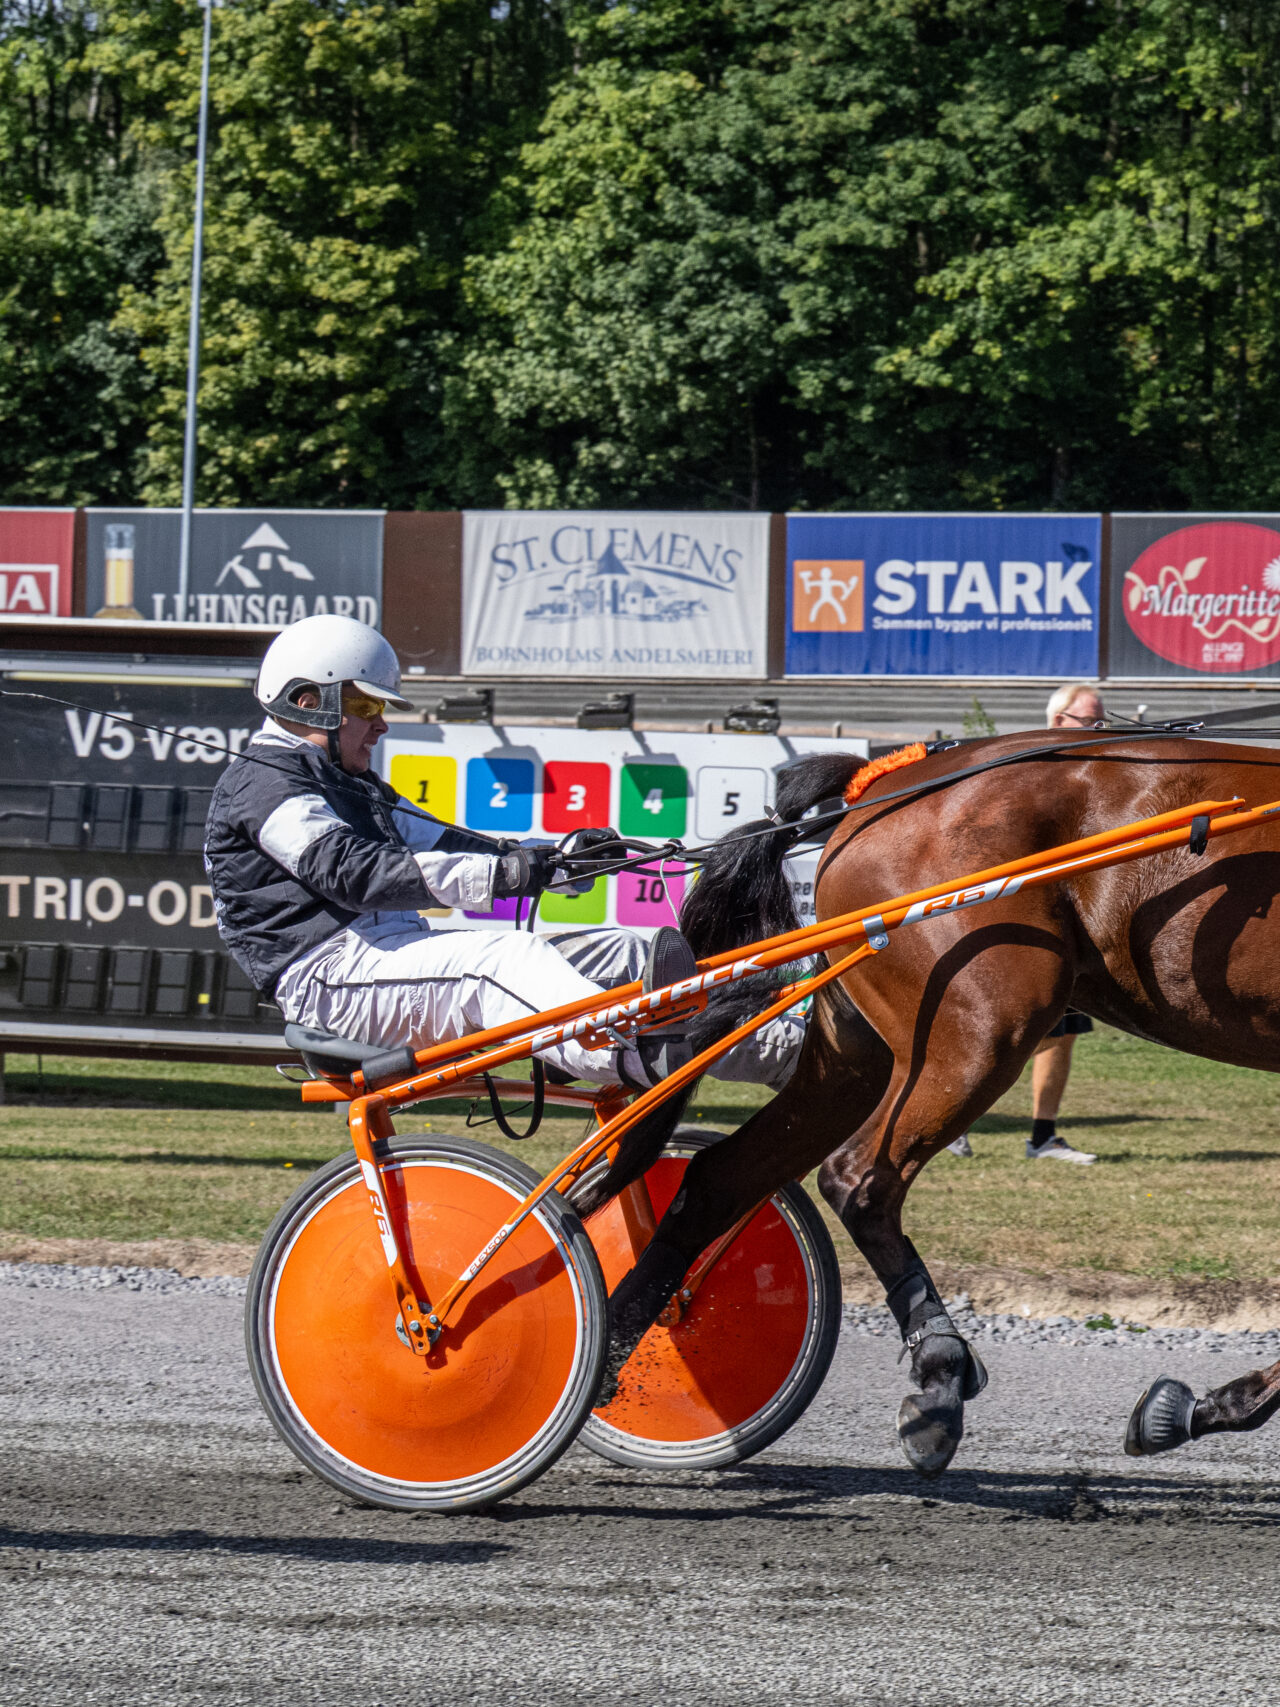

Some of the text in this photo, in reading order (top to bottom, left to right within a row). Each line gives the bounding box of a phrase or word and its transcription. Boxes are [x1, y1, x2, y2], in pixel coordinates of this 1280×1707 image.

[491, 525, 743, 584] ST. CLEMENS
[0, 574, 46, 611] A
[873, 559, 1093, 615] STARK
[872, 616, 1093, 633] Sammen bygger vi professionelt
[476, 647, 753, 665] BORNHOLMS ANDELSMEJERI
[65, 709, 257, 765] V5 vær
[416, 780, 740, 816] 1 2 3 4 5
[635, 878, 665, 904] 10
[531, 953, 766, 1052] FINNTACK
